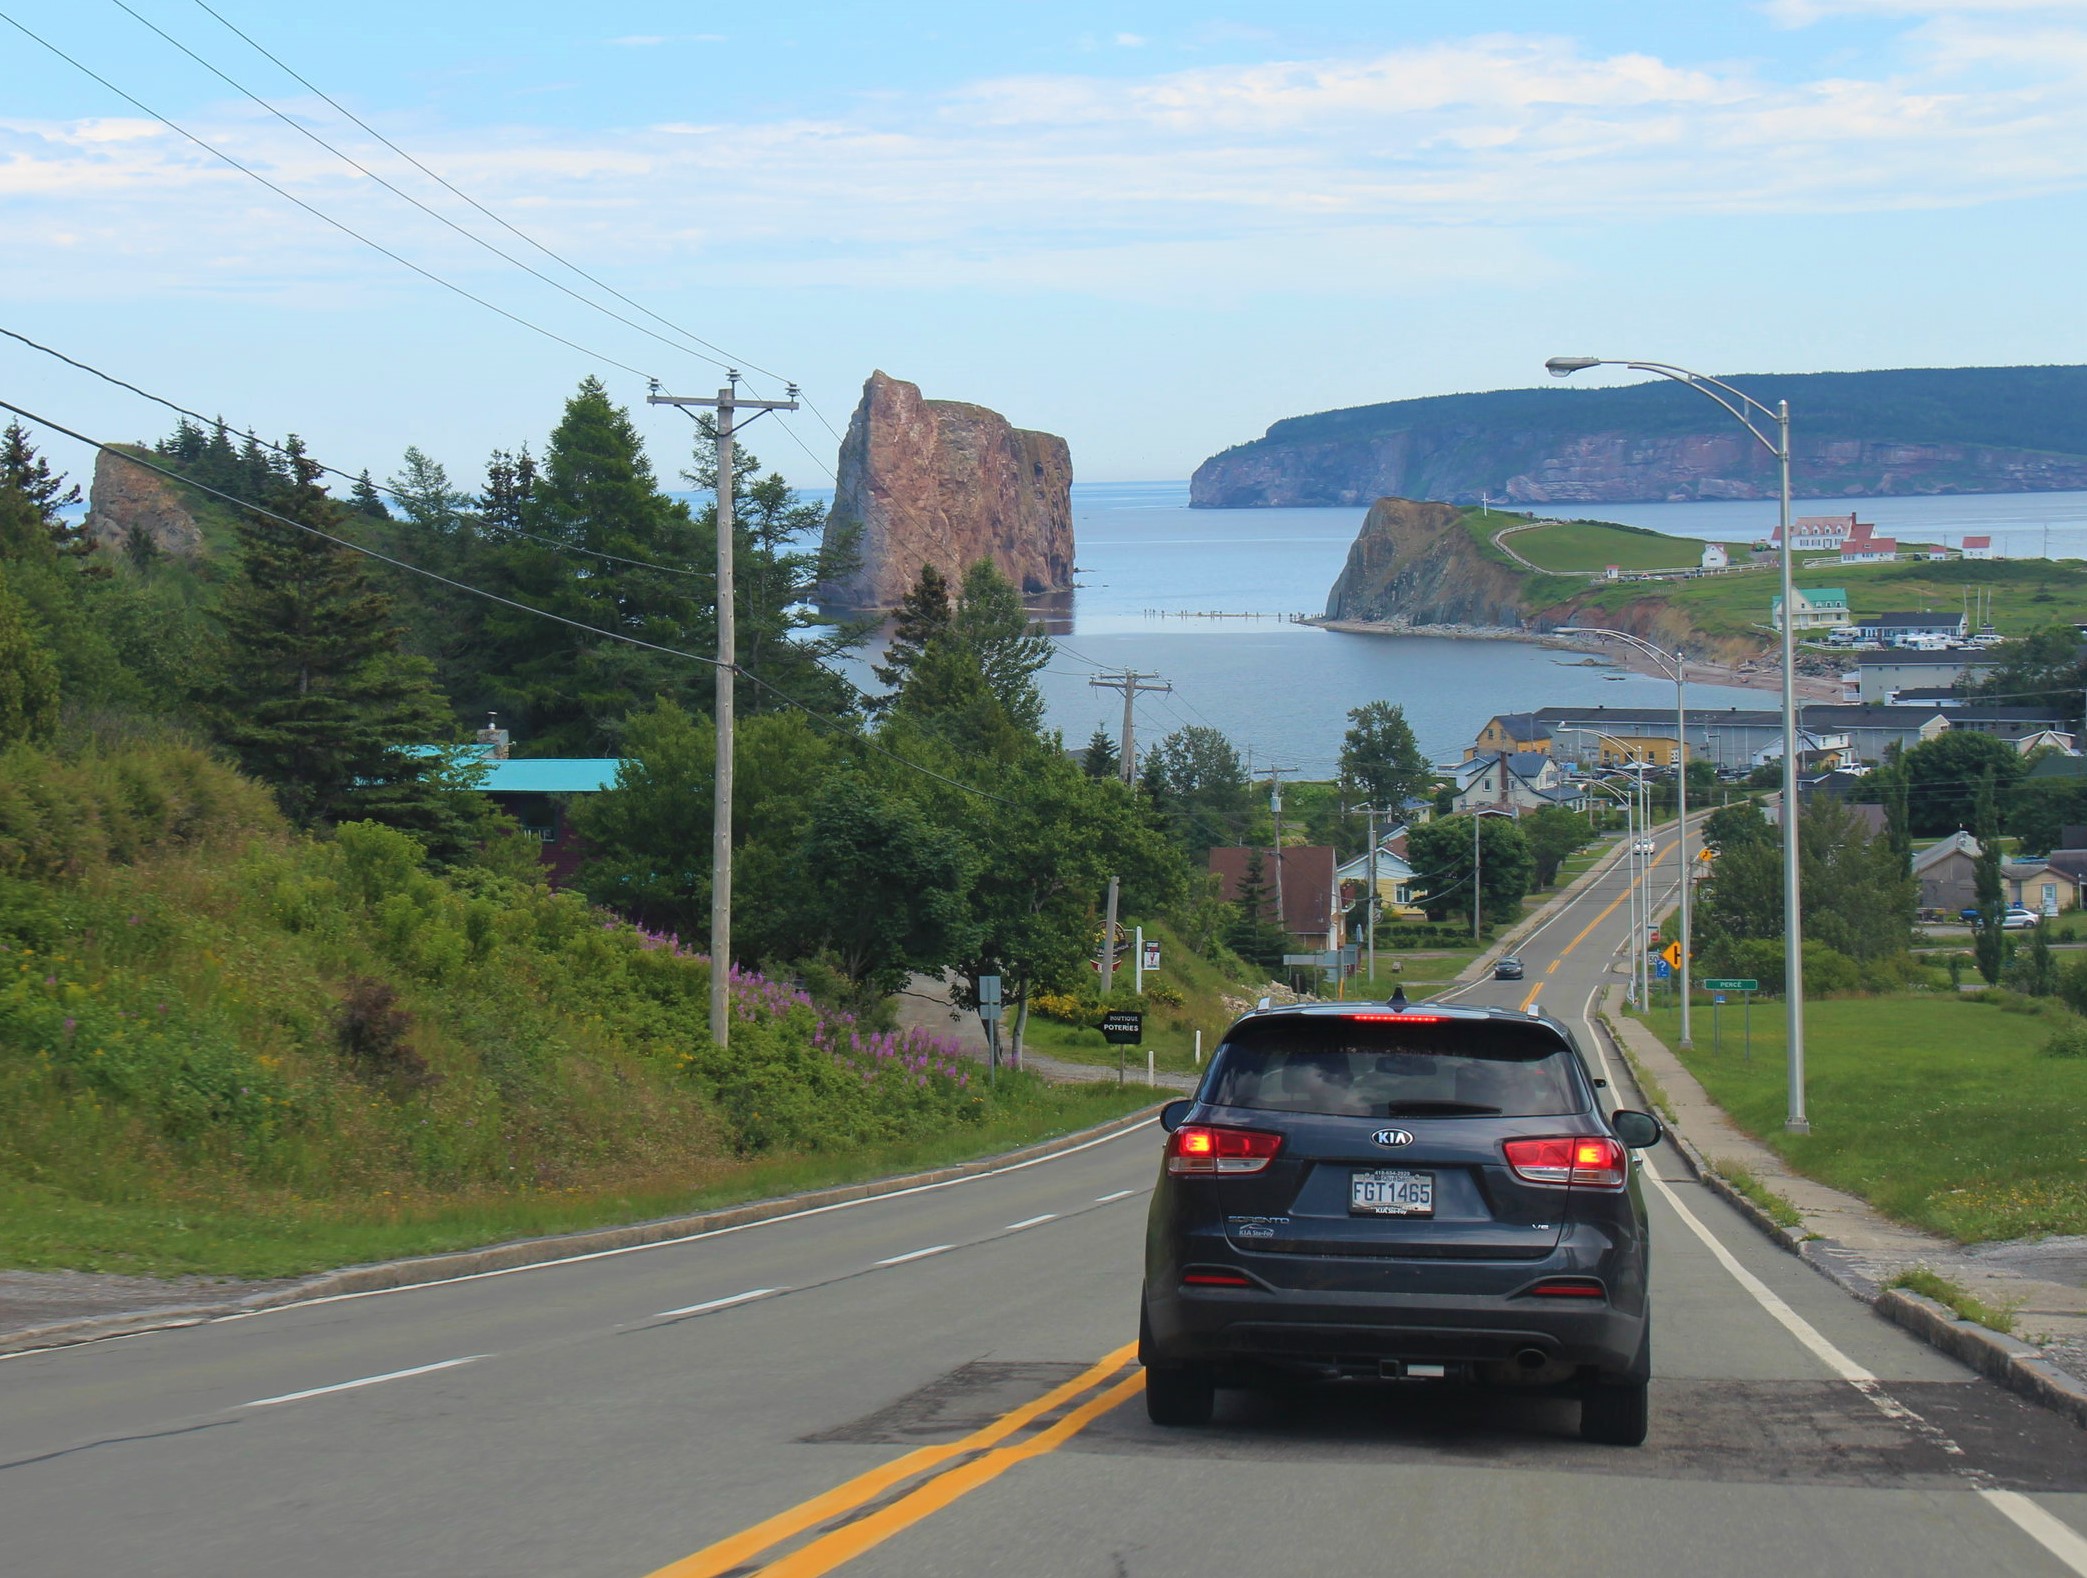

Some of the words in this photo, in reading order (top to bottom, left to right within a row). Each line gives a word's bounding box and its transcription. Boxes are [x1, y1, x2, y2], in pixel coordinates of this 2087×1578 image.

[1378, 1132, 1407, 1144] KIA
[1353, 1181, 1431, 1204] FGT1465
[1375, 1206, 1388, 1214] KIA
